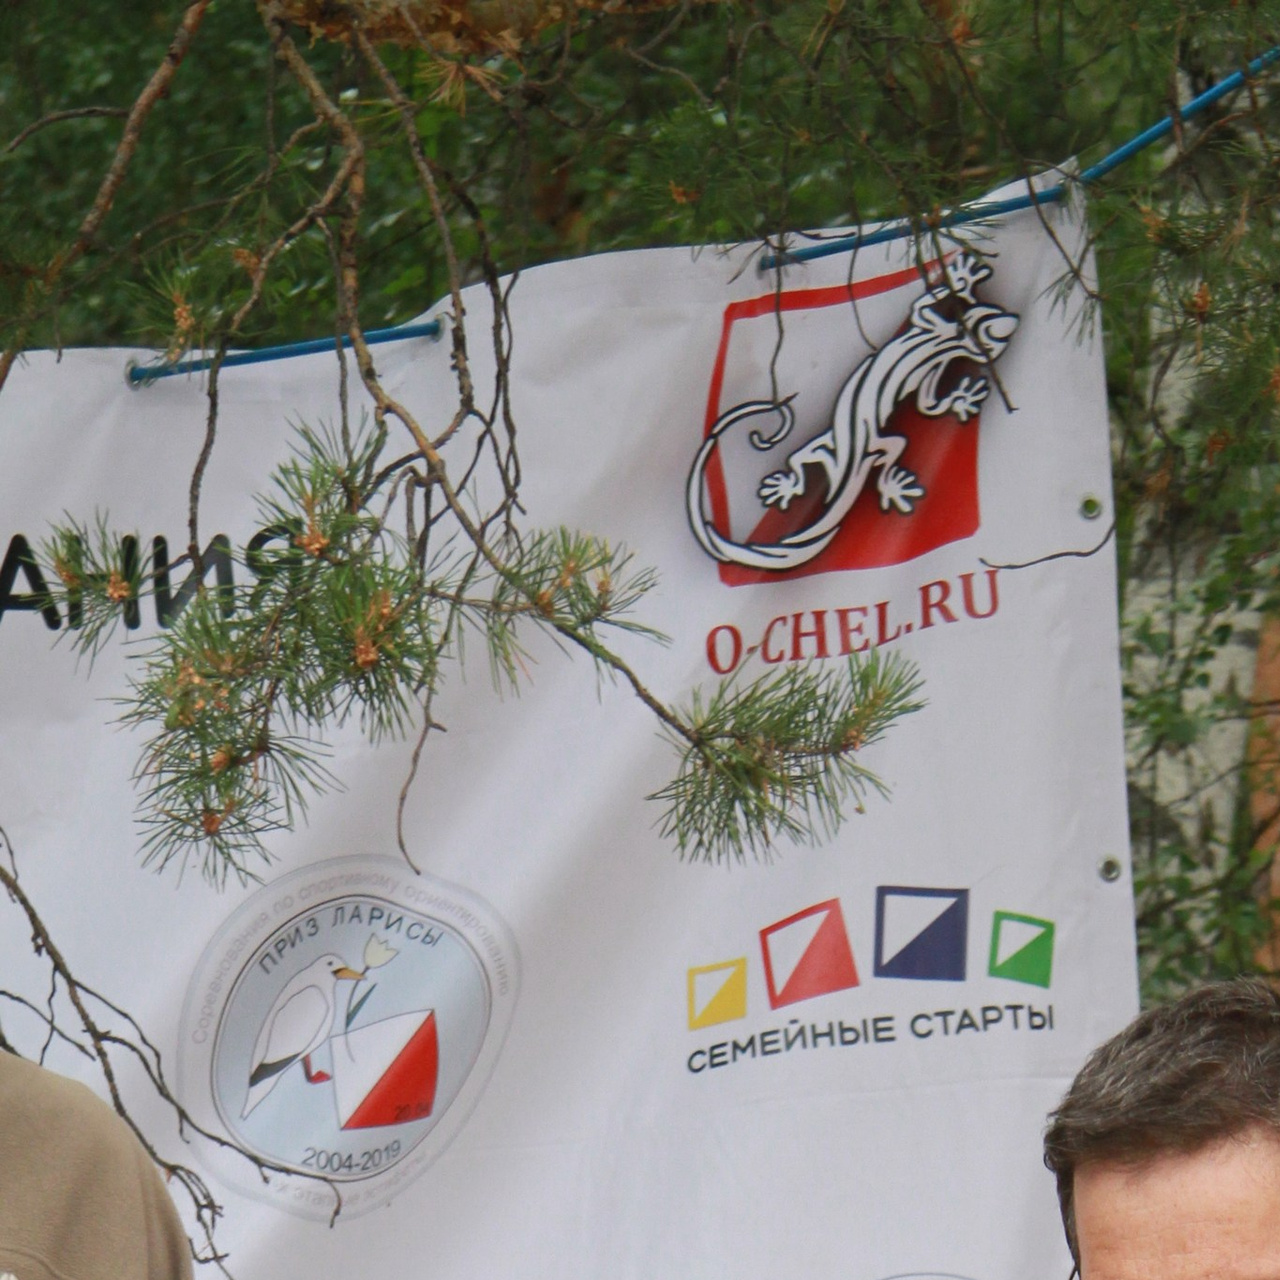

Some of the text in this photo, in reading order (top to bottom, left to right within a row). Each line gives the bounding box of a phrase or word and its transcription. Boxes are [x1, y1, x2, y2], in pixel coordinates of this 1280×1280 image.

[705, 569, 1000, 675] O-CHEL.RU
[258, 905, 445, 975] ПРИЗ ЛАРИСЫ
[687, 1004, 1055, 1074] СЕМЕЙНЫЕ СТАРТЫ
[301, 1140, 402, 1173] 2004-2019
